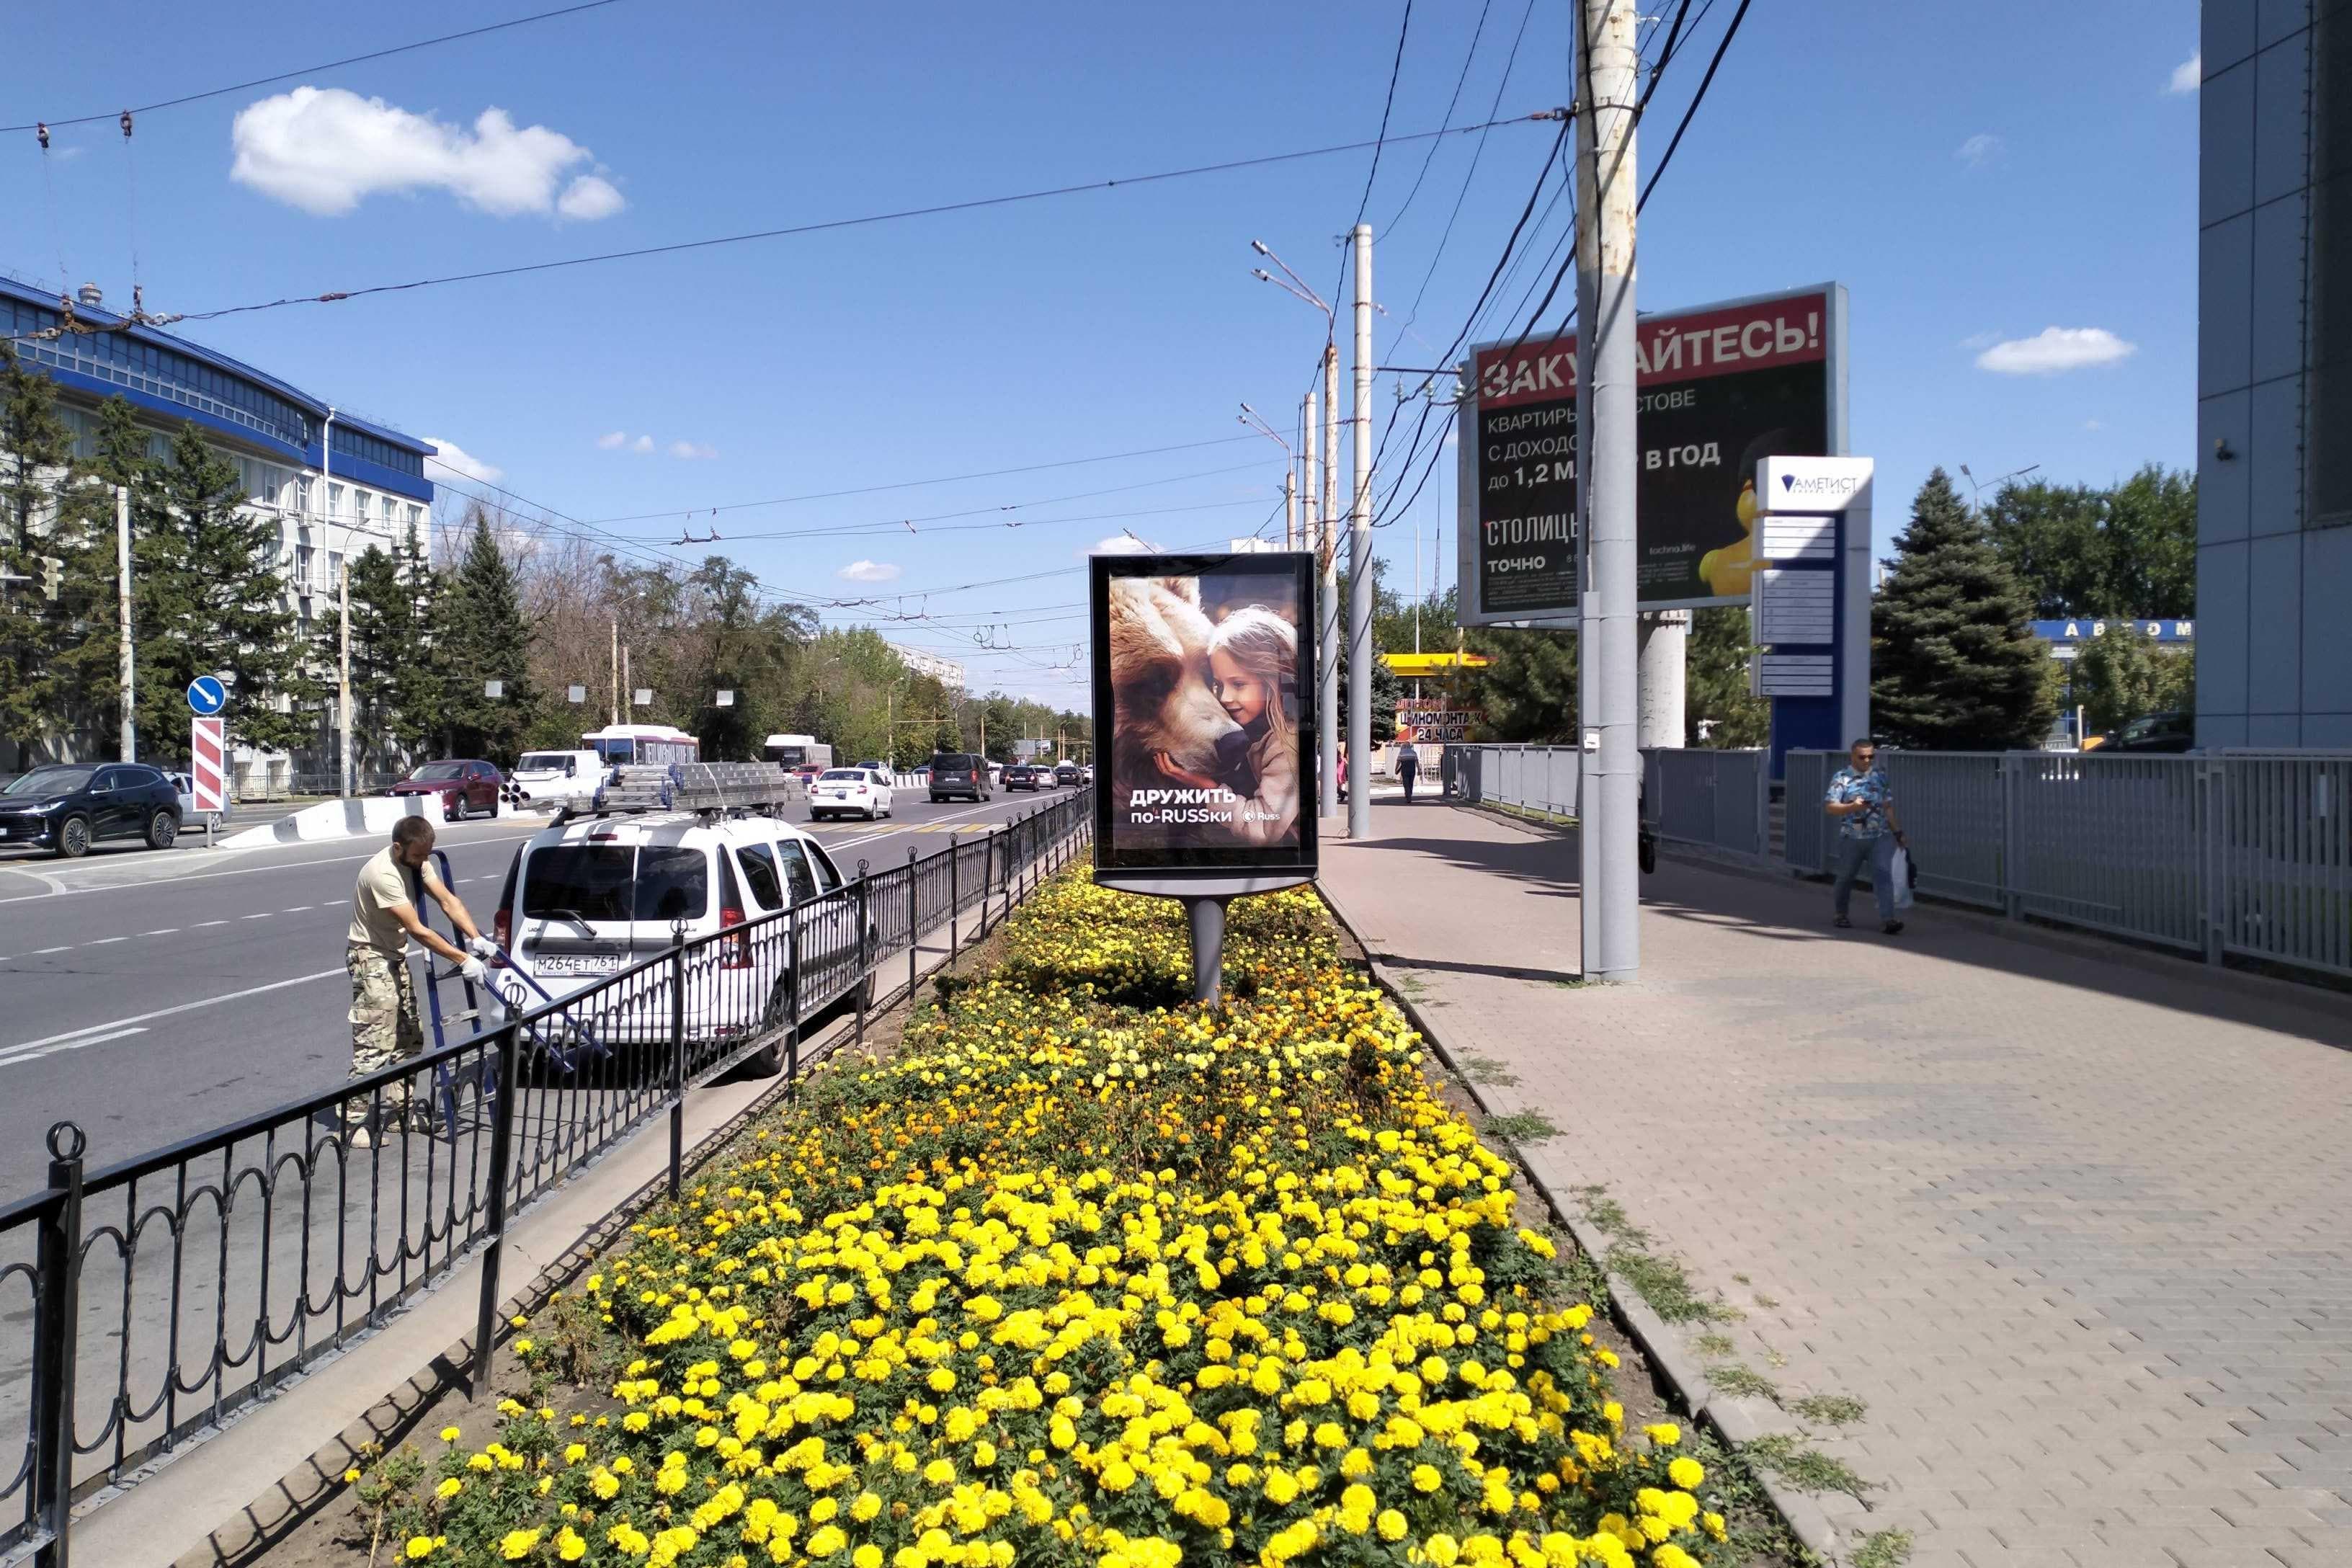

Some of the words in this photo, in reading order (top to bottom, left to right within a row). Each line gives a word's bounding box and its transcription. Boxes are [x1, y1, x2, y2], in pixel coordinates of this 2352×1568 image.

[1482, 312, 1819, 398] ЗАКУАЙТЕСЬ!
[1636, 389, 1696, 414] СТОВЕ
[1488, 445, 1500, 462] С
[1505, 435, 1579, 463] ДОХОДО
[1514, 463, 1549, 488] 1,2
[1646, 450, 1662, 470] В
[1668, 442, 1721, 468] ГОД
[1793, 477, 1858, 490] АМЕТИСТ
[1418, 729, 1432, 741] 24
[1435, 729, 1464, 741] ЧАСА
[1130, 788, 1237, 807] ДРУЖИТЬ
[1131, 808, 1232, 824] по-RUSSки
[1257, 811, 1280, 820] Russ
[538, 956, 589, 971] М264ЕТ
[594, 956, 615, 967] 761
